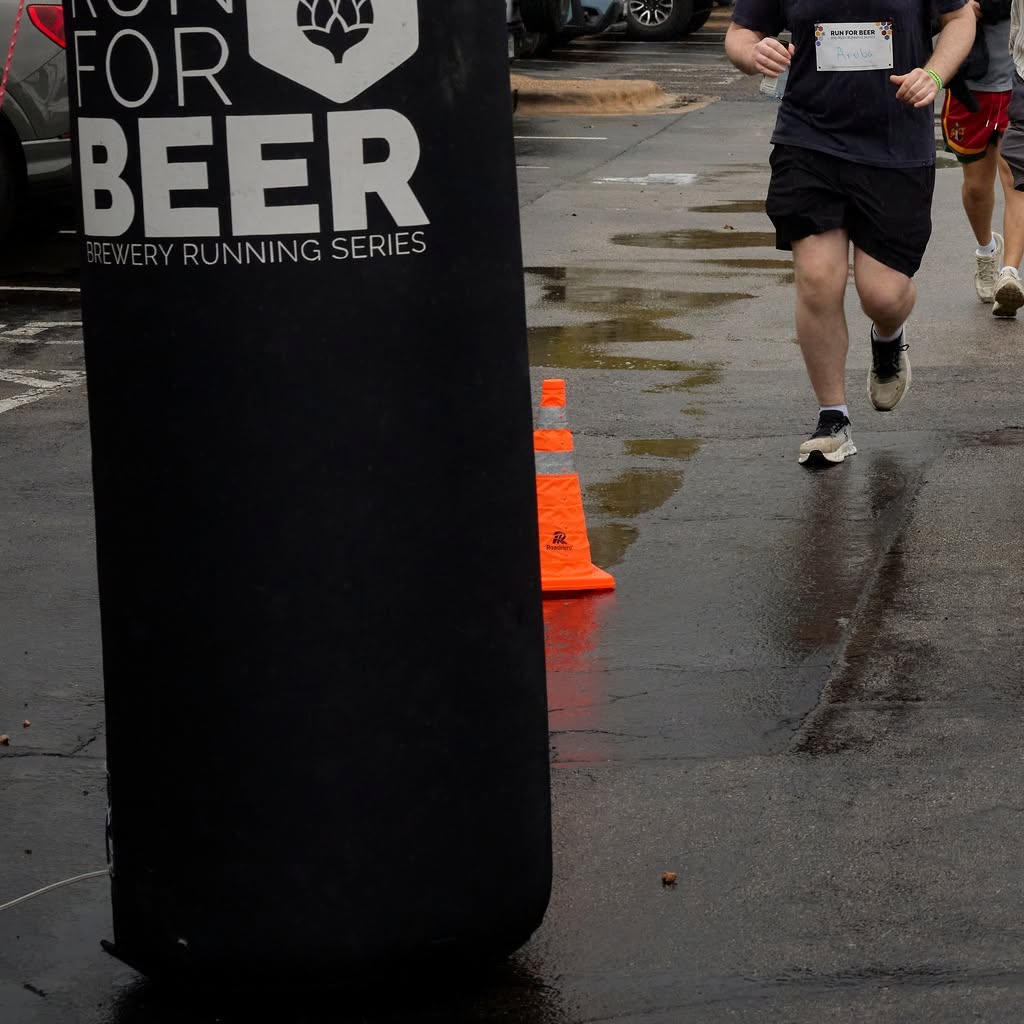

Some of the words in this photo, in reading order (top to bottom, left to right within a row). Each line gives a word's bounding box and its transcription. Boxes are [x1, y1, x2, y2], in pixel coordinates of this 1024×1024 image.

[74, 26, 233, 108] FOR
[77, 108, 431, 238] BEER
[87, 242, 174, 266] BREWERY
[183, 239, 321, 265] RUNNING
[331, 230, 427, 260] SERIES
